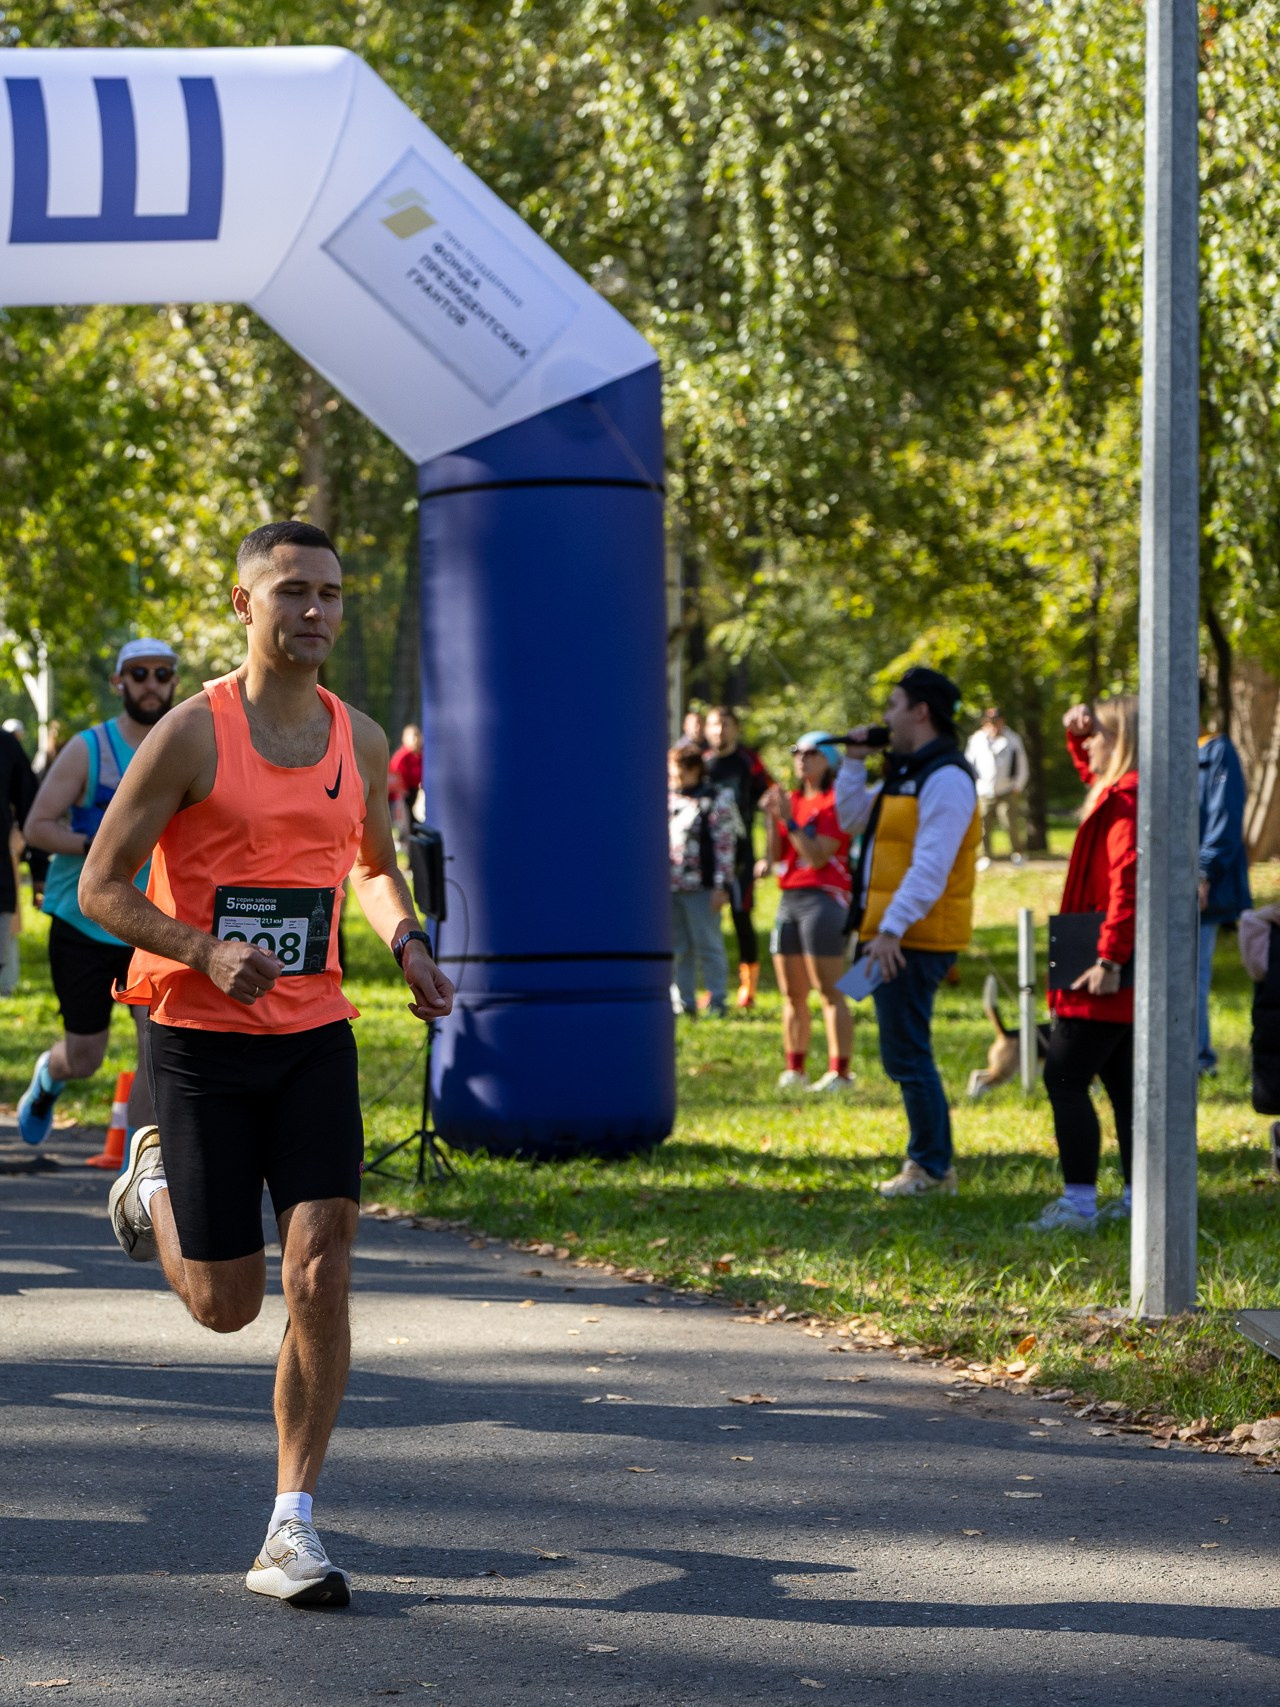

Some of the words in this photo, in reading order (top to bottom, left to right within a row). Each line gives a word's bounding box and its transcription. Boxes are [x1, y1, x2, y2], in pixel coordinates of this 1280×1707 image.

[432, 242, 480, 292] ФОНДА
[405, 267, 469, 327] ГРАНТОВ
[419, 254, 530, 359] ПРЕЗИДЕНТСКИХ
[226, 897, 236, 909] 5
[235, 902, 277, 912] городов
